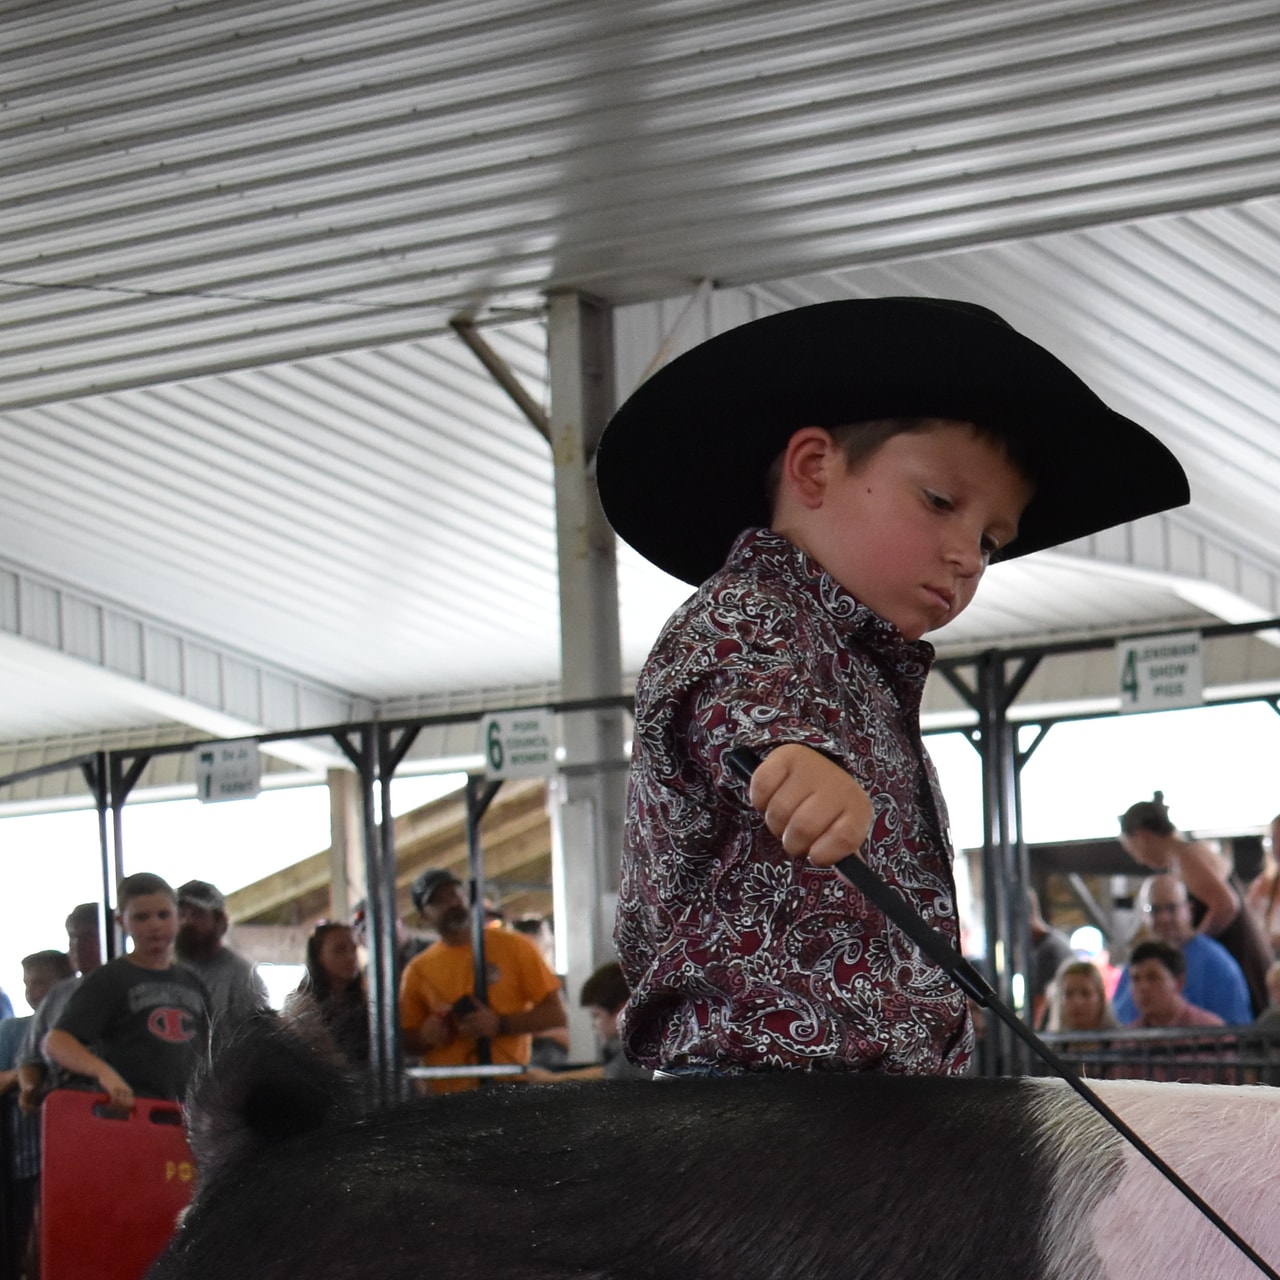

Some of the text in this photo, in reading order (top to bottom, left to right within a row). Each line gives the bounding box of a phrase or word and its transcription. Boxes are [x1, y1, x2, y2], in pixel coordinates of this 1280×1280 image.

[1121, 648, 1138, 703] 4
[1149, 663, 1188, 680] SHOW
[486, 720, 504, 772] 6
[200, 751, 215, 798] 7
